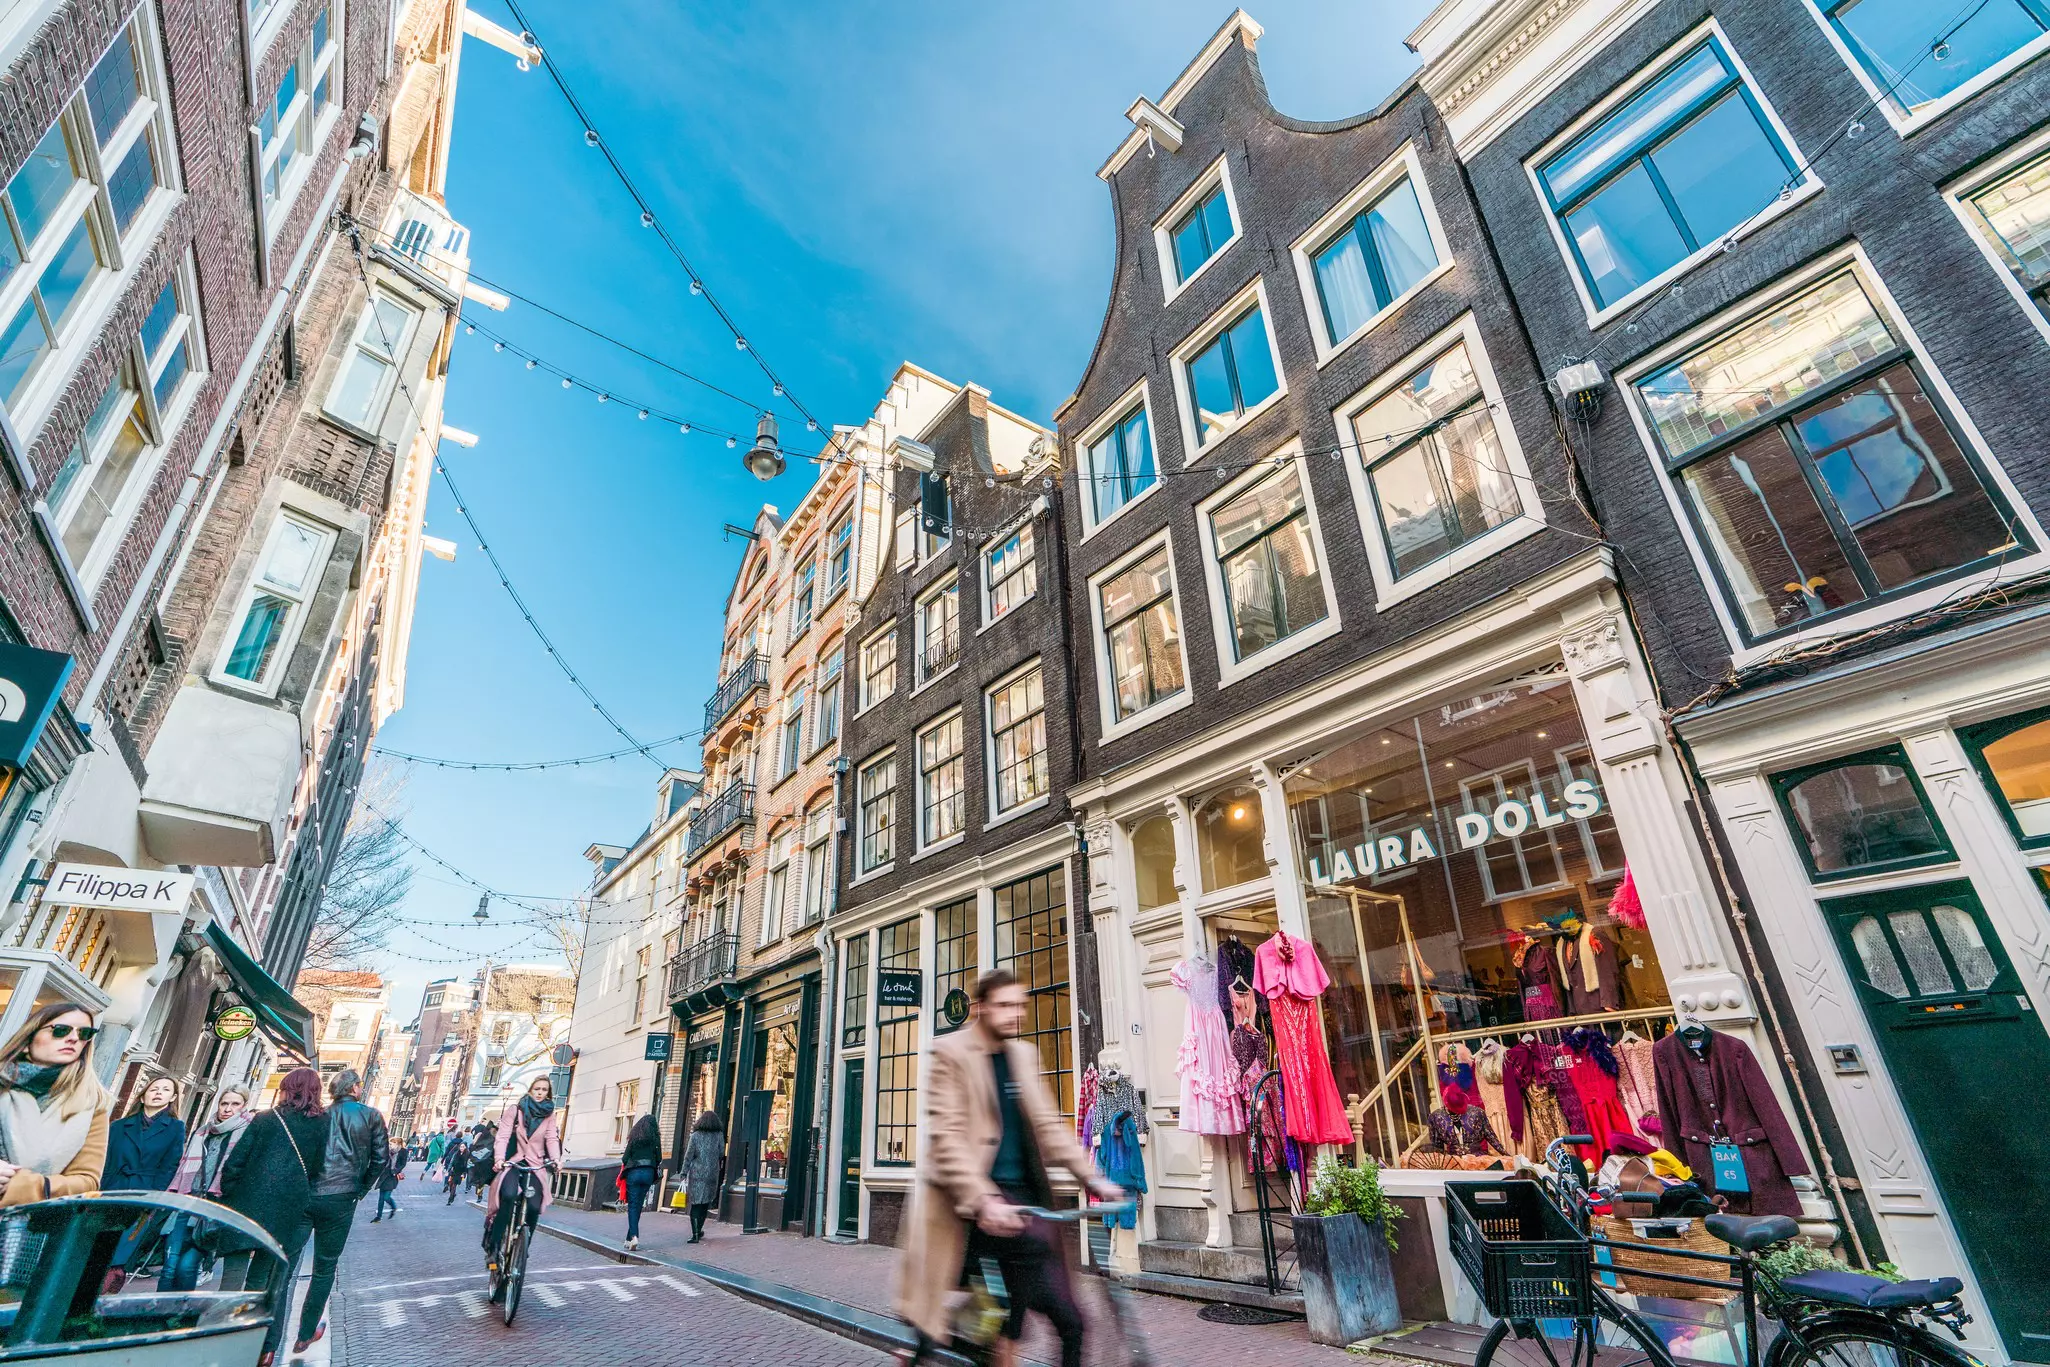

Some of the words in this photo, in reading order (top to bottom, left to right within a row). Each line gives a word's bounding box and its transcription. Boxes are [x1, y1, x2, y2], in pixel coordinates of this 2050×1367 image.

[1309, 826, 1438, 888] LAURA
[1455, 778, 1603, 850] DOLS
[57, 871, 148, 902] Filippa
[153, 880, 177, 902] K
[1715, 1151, 1739, 1162] BAK
[1723, 1169, 1737, 1180] €5
